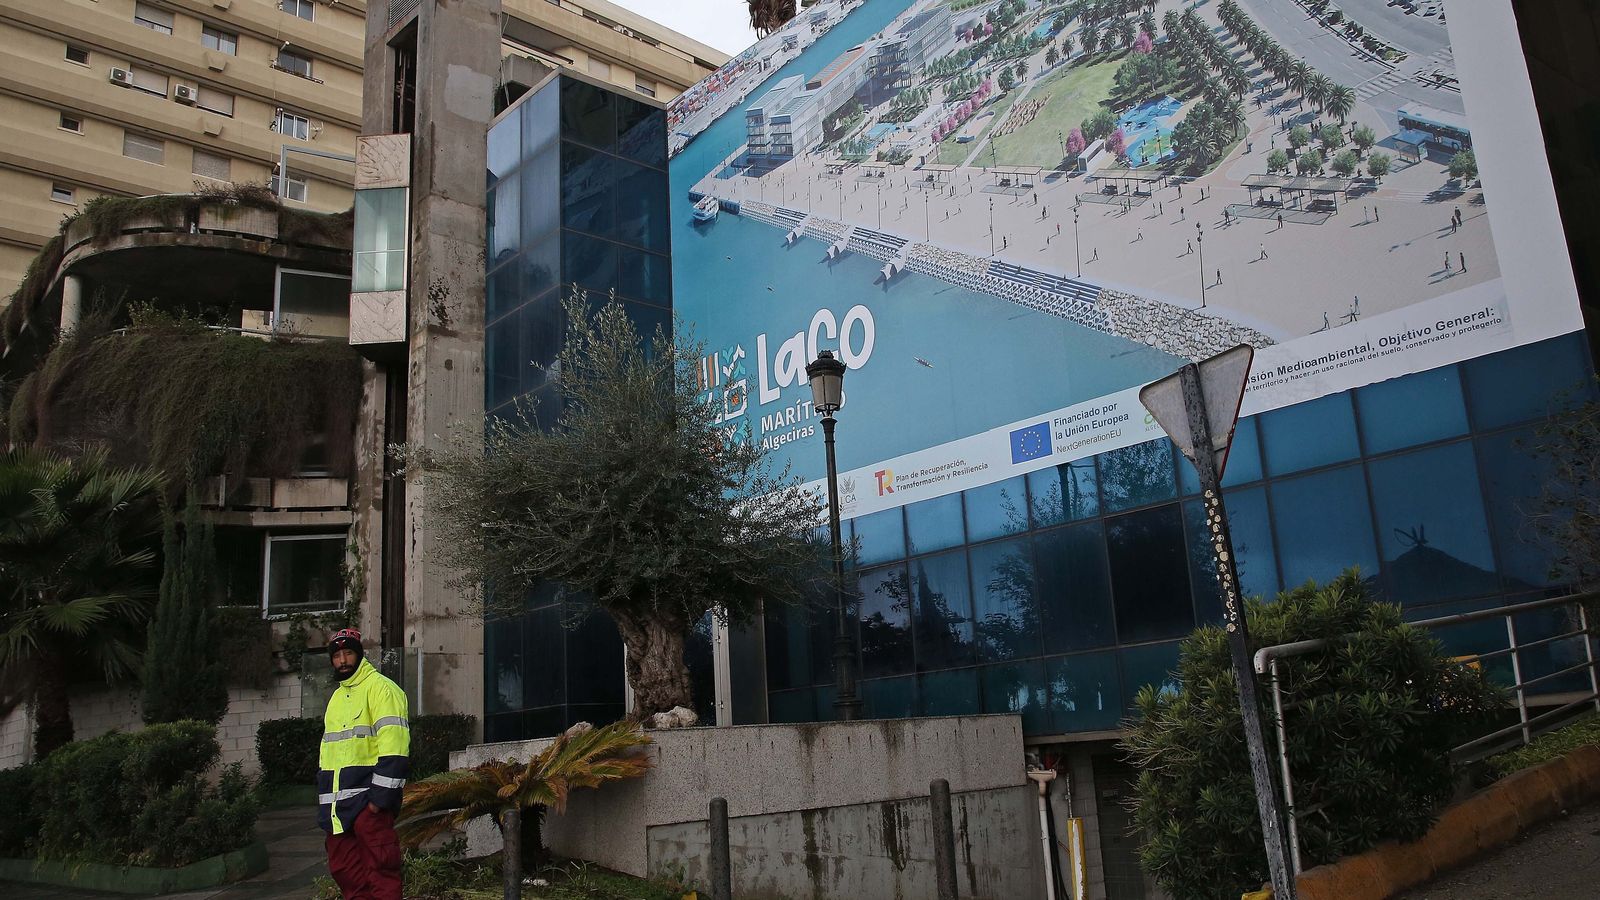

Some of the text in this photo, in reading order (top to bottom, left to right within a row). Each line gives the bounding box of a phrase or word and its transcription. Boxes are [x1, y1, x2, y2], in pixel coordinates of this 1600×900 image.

[1253, 378, 1283, 391] territorio
[1290, 371, 1311, 381] hacer
[1321, 365, 1334, 373] uso
[1336, 357, 1366, 368] racional
[1367, 352, 1380, 360] del
[1405, 332, 1450, 350] conservado
[1458, 318, 1502, 336] protegerlo
[1277, 342, 1375, 376] Medioambiental,
[1378, 327, 1432, 347] Objetivo
[1435, 307, 1495, 331] General:
[761, 390, 847, 434] MARÍT
[1053, 402, 1118, 427] Financiado por
[762, 424, 815, 451] Algeciras
[1055, 430, 1063, 440] la
[1064, 422, 1090, 437] Unión
[1092, 413, 1129, 430] Europea
[1056, 428, 1122, 454] NextGenerationEU
[895, 459, 967, 483] Plan de Recuperación,
[896, 462, 989, 492] Transformación y Resiliencia
